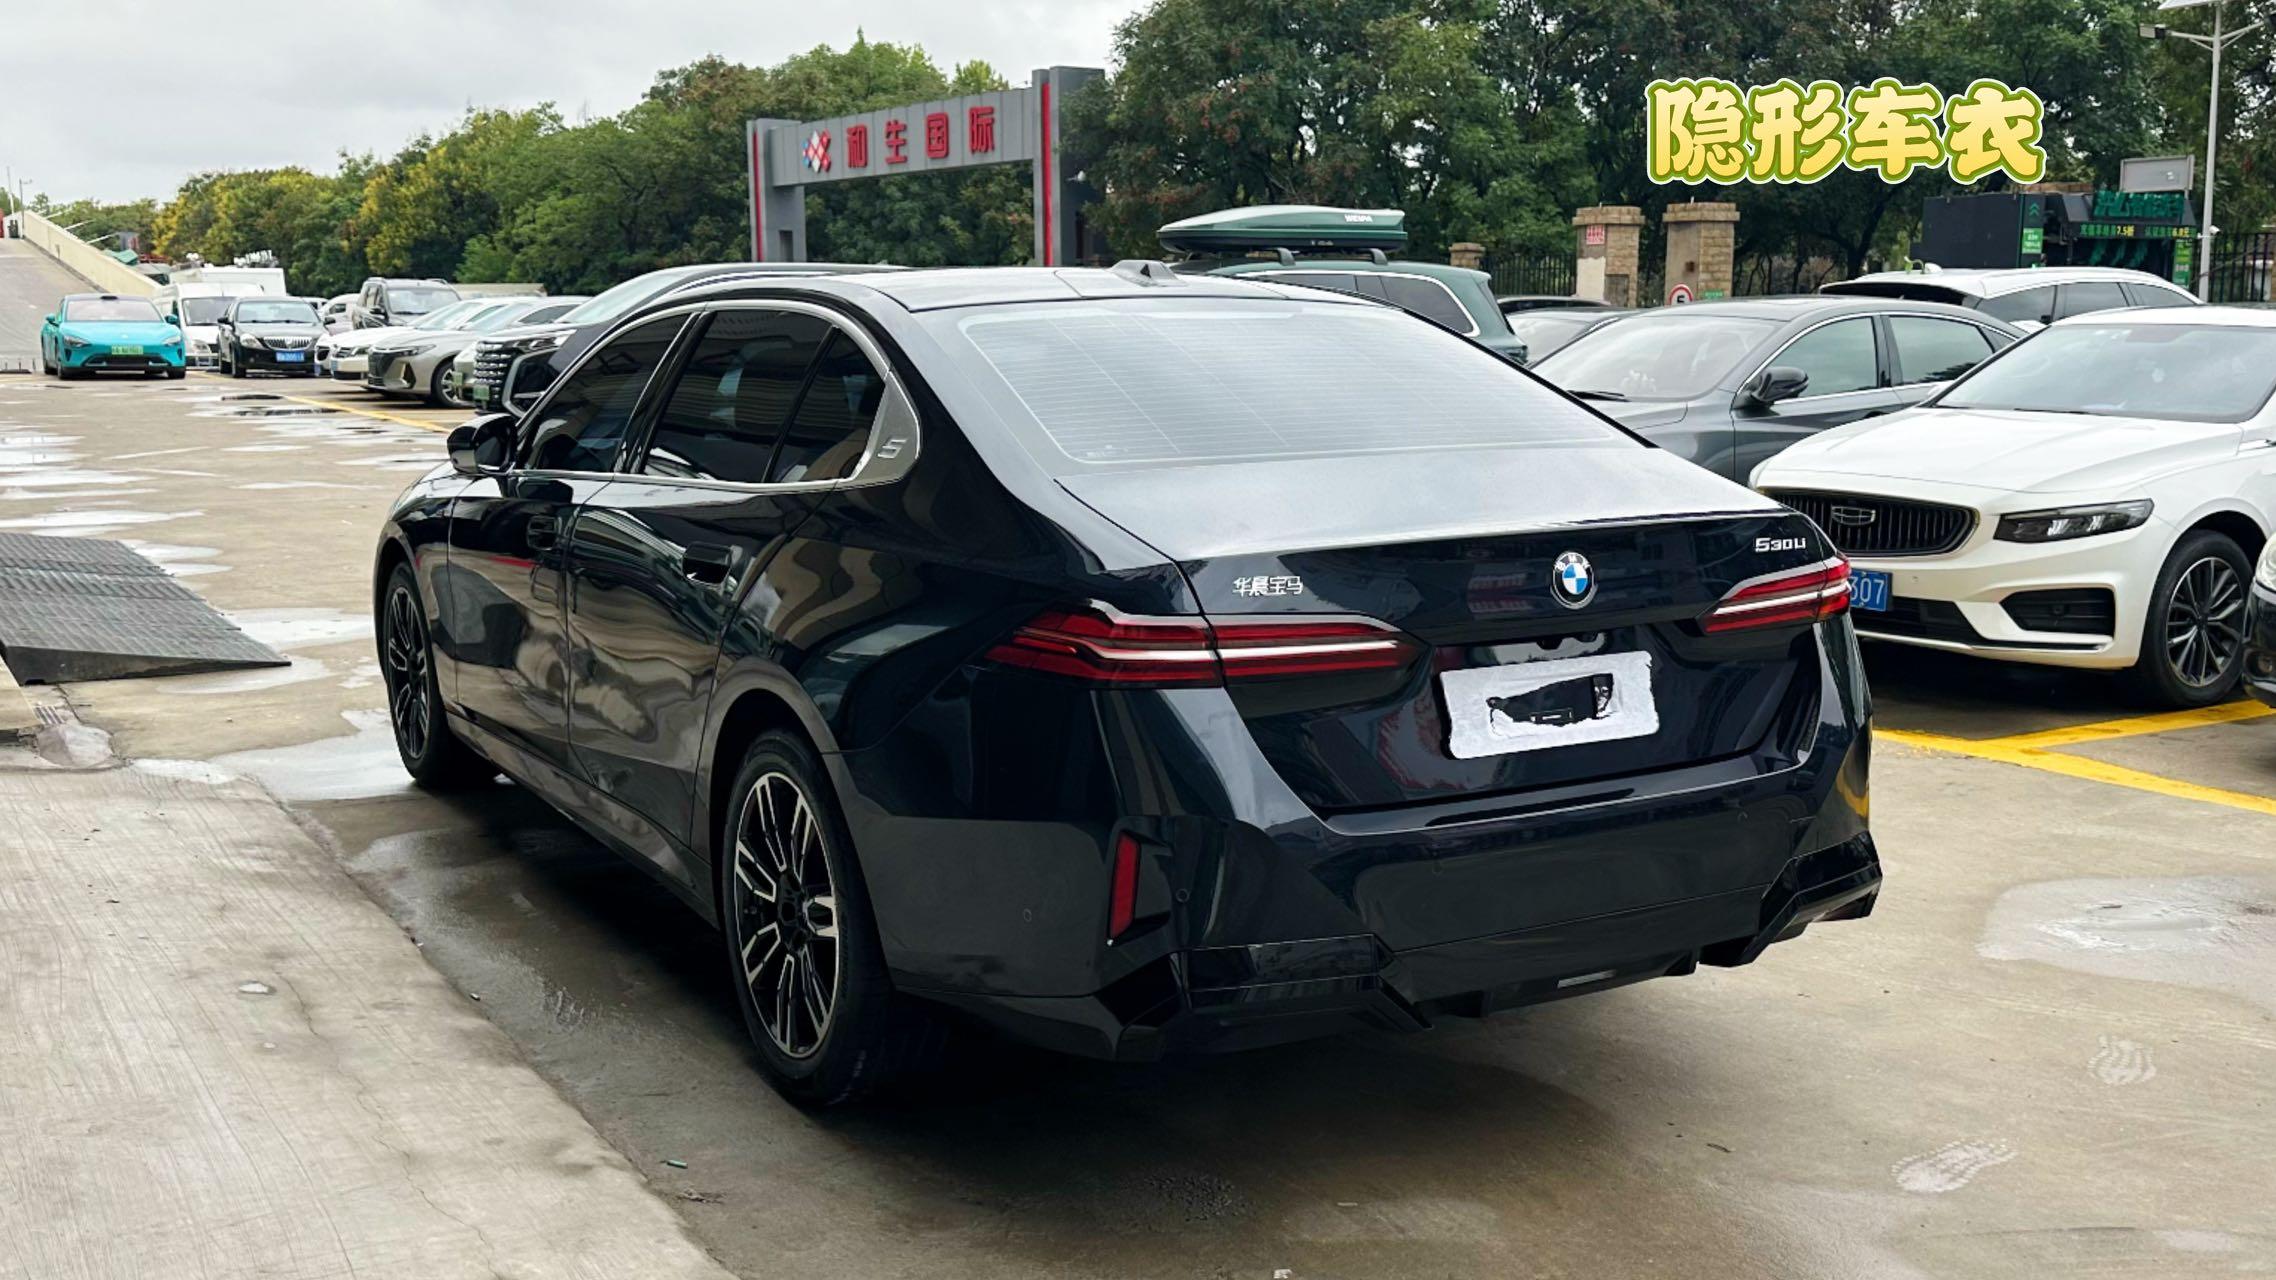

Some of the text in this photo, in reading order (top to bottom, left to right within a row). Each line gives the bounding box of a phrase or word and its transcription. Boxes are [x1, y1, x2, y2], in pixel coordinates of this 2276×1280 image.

[846, 105, 996, 168] 和生国际
[1232, 575, 1304, 598] 华晨宝马
